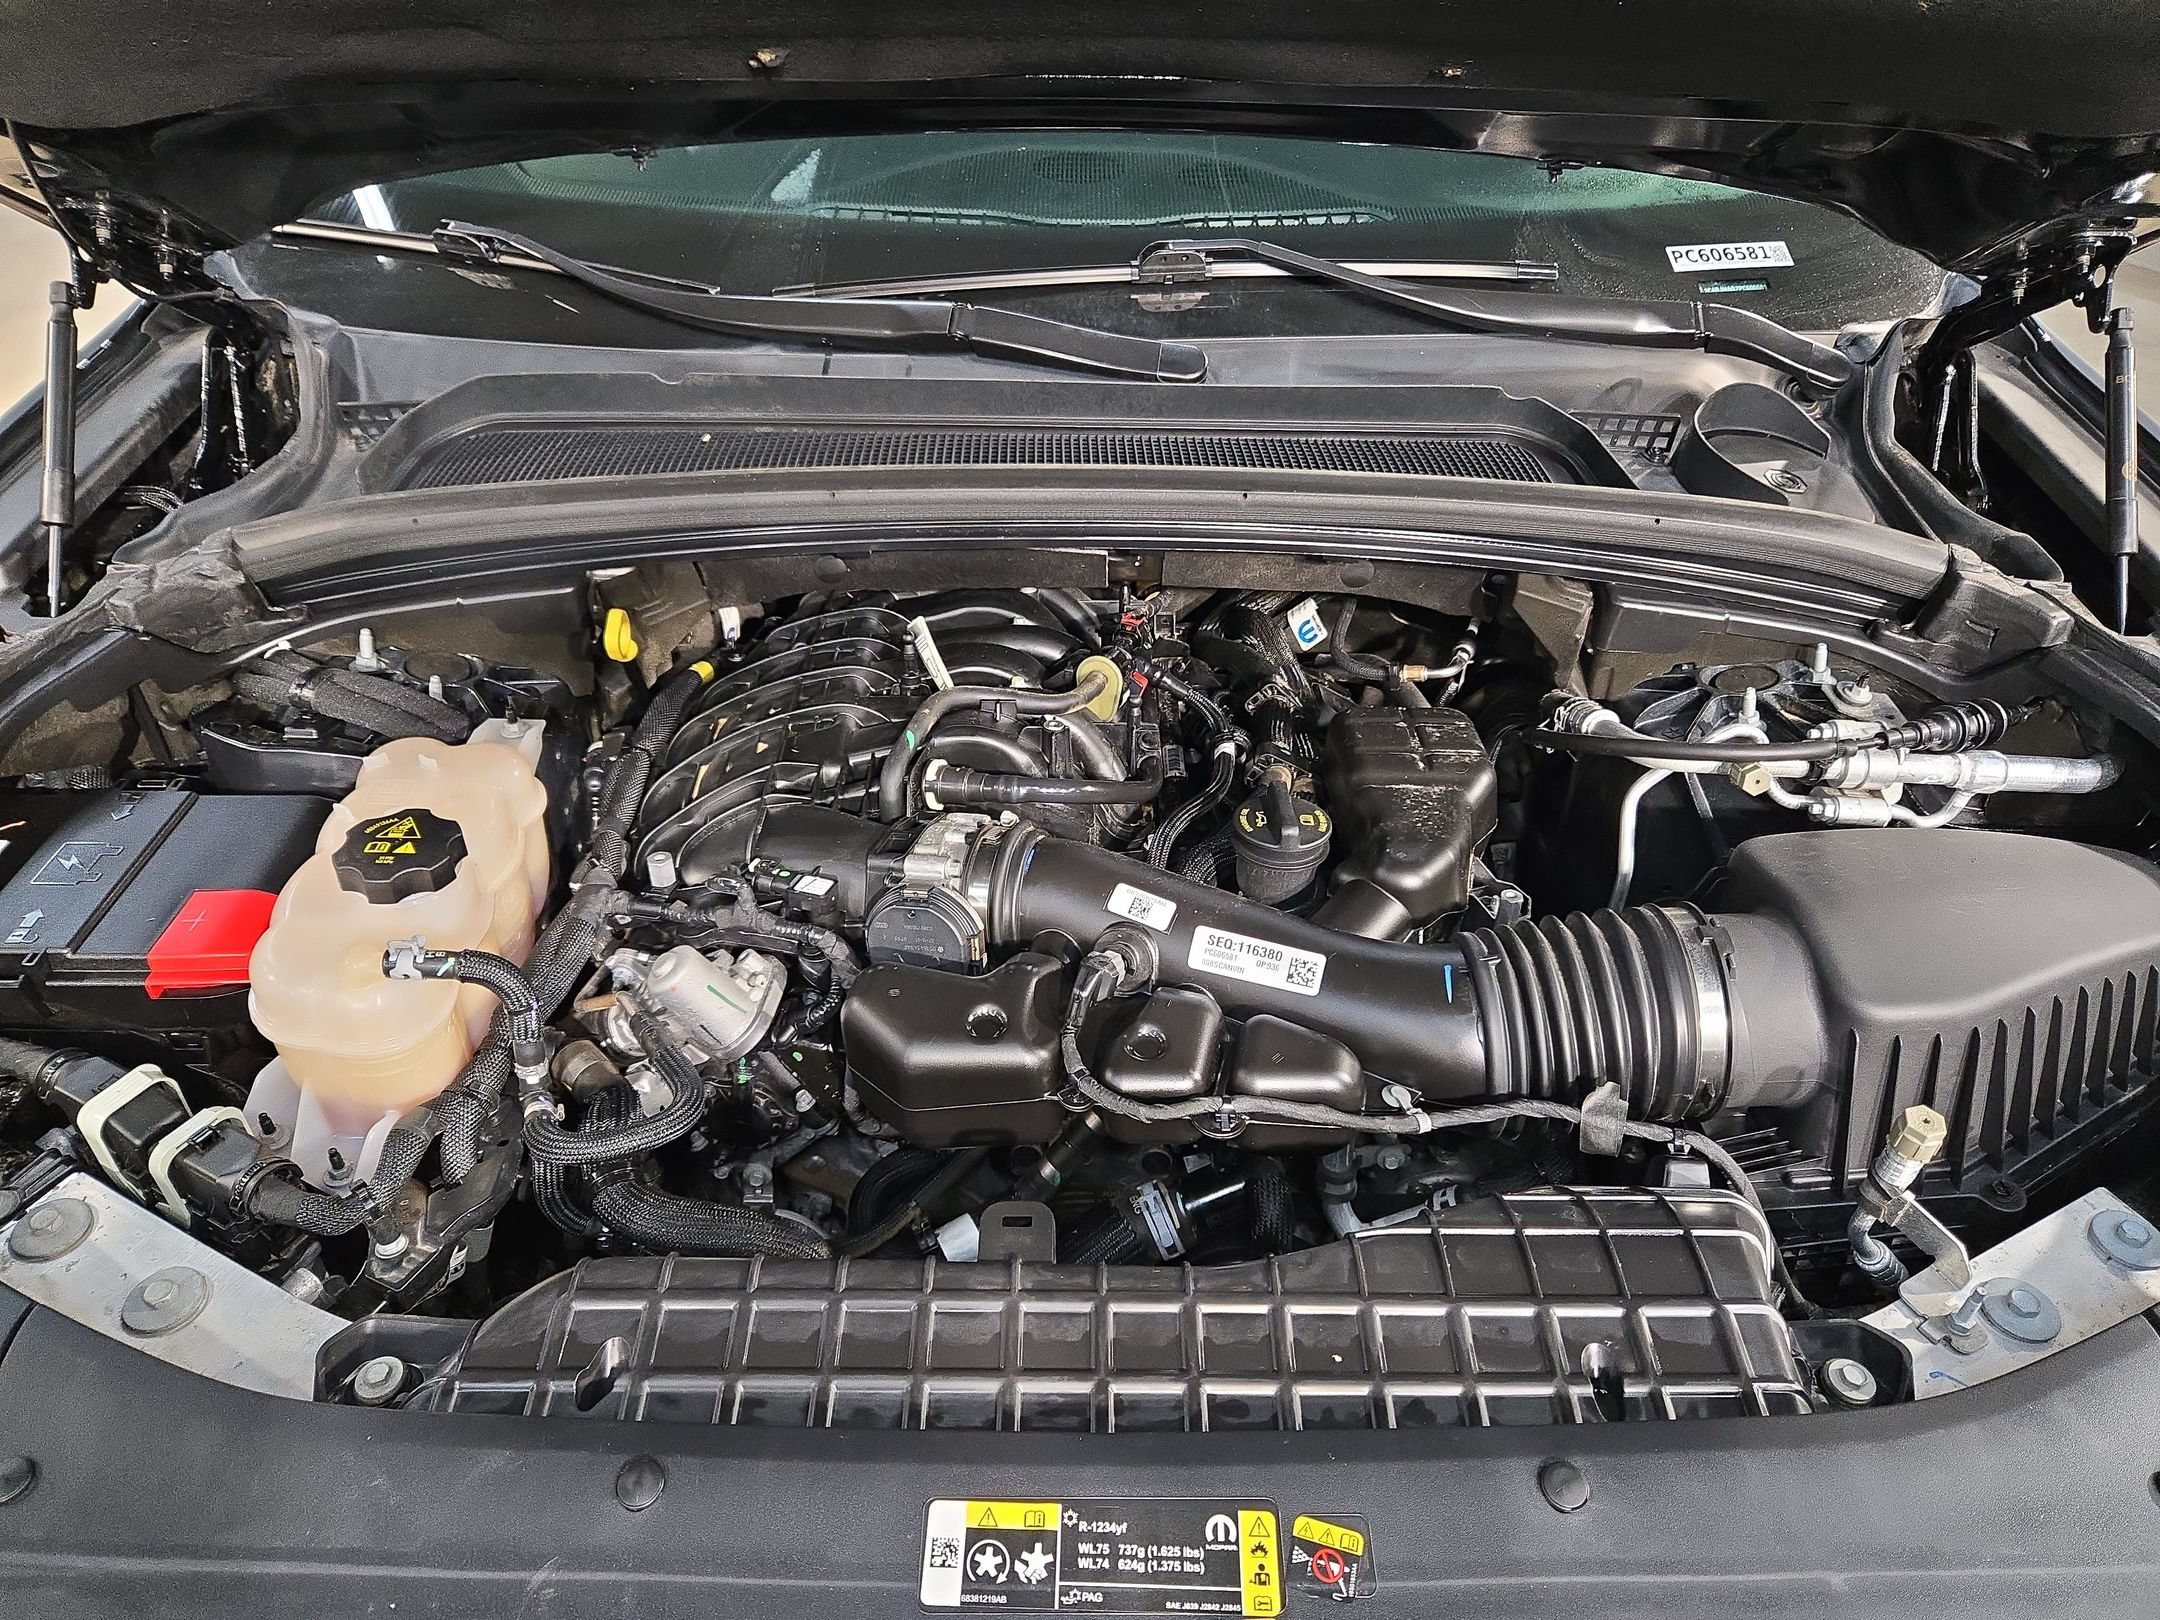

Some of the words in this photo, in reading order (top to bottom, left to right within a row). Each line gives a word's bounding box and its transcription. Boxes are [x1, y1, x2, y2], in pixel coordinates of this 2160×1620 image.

[1671, 245, 1771, 264] PC606581
[1207, 934, 1283, 962] SEQ:116380
[1078, 1520, 1128, 1536] R-1234yf
[1077, 1542, 1111, 1555] WL75
[1117, 1543, 1146, 1559] 737g
[1147, 1544, 1182, 1559] (1.625
[1183, 1545, 1205, 1560] lbs)
[1077, 1557, 1110, 1570] WL74
[1117, 1558, 1146, 1573] 624g
[1147, 1559, 1182, 1573] (1.375
[1183, 1560, 1205, 1575] lbs)
[960, 1594, 1008, 1604] 68381219AB
[1081, 1591, 1104, 1603] PAG
[1165, 1601, 1181, 1609] SAE
